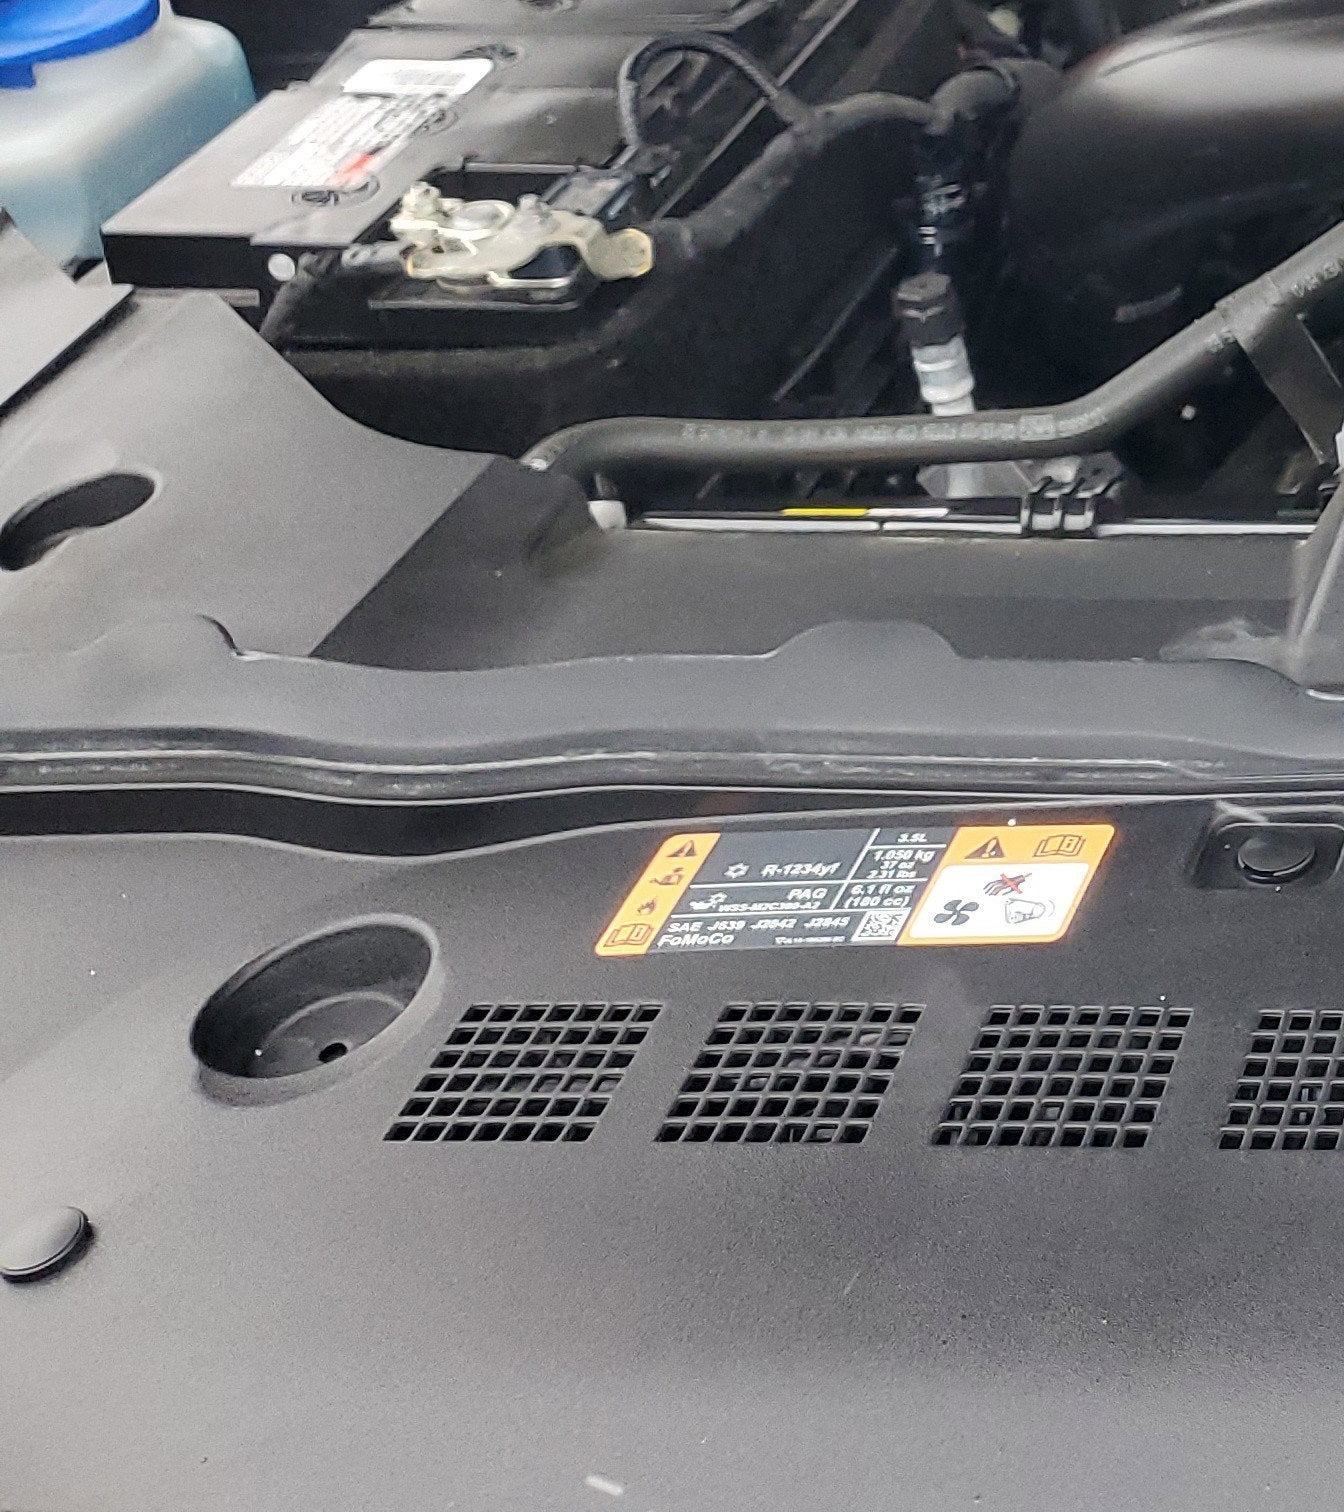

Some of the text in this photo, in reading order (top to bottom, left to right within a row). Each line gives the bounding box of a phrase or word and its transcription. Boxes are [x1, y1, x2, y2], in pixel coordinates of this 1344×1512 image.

[897, 832, 927, 843] 3.5L
[874, 849, 936, 863] 1.050 kg
[880, 860, 916, 870] 37 oz
[866, 870, 917, 879] 2.31 lbs
[787, 888, 828, 901] PAG
[851, 884, 877, 895] 6.1
[893, 885, 916, 894] oz
[844, 896, 910, 909] (180 cc)
[667, 921, 703, 933] SAE
[656, 933, 735, 947] FoMoCo
